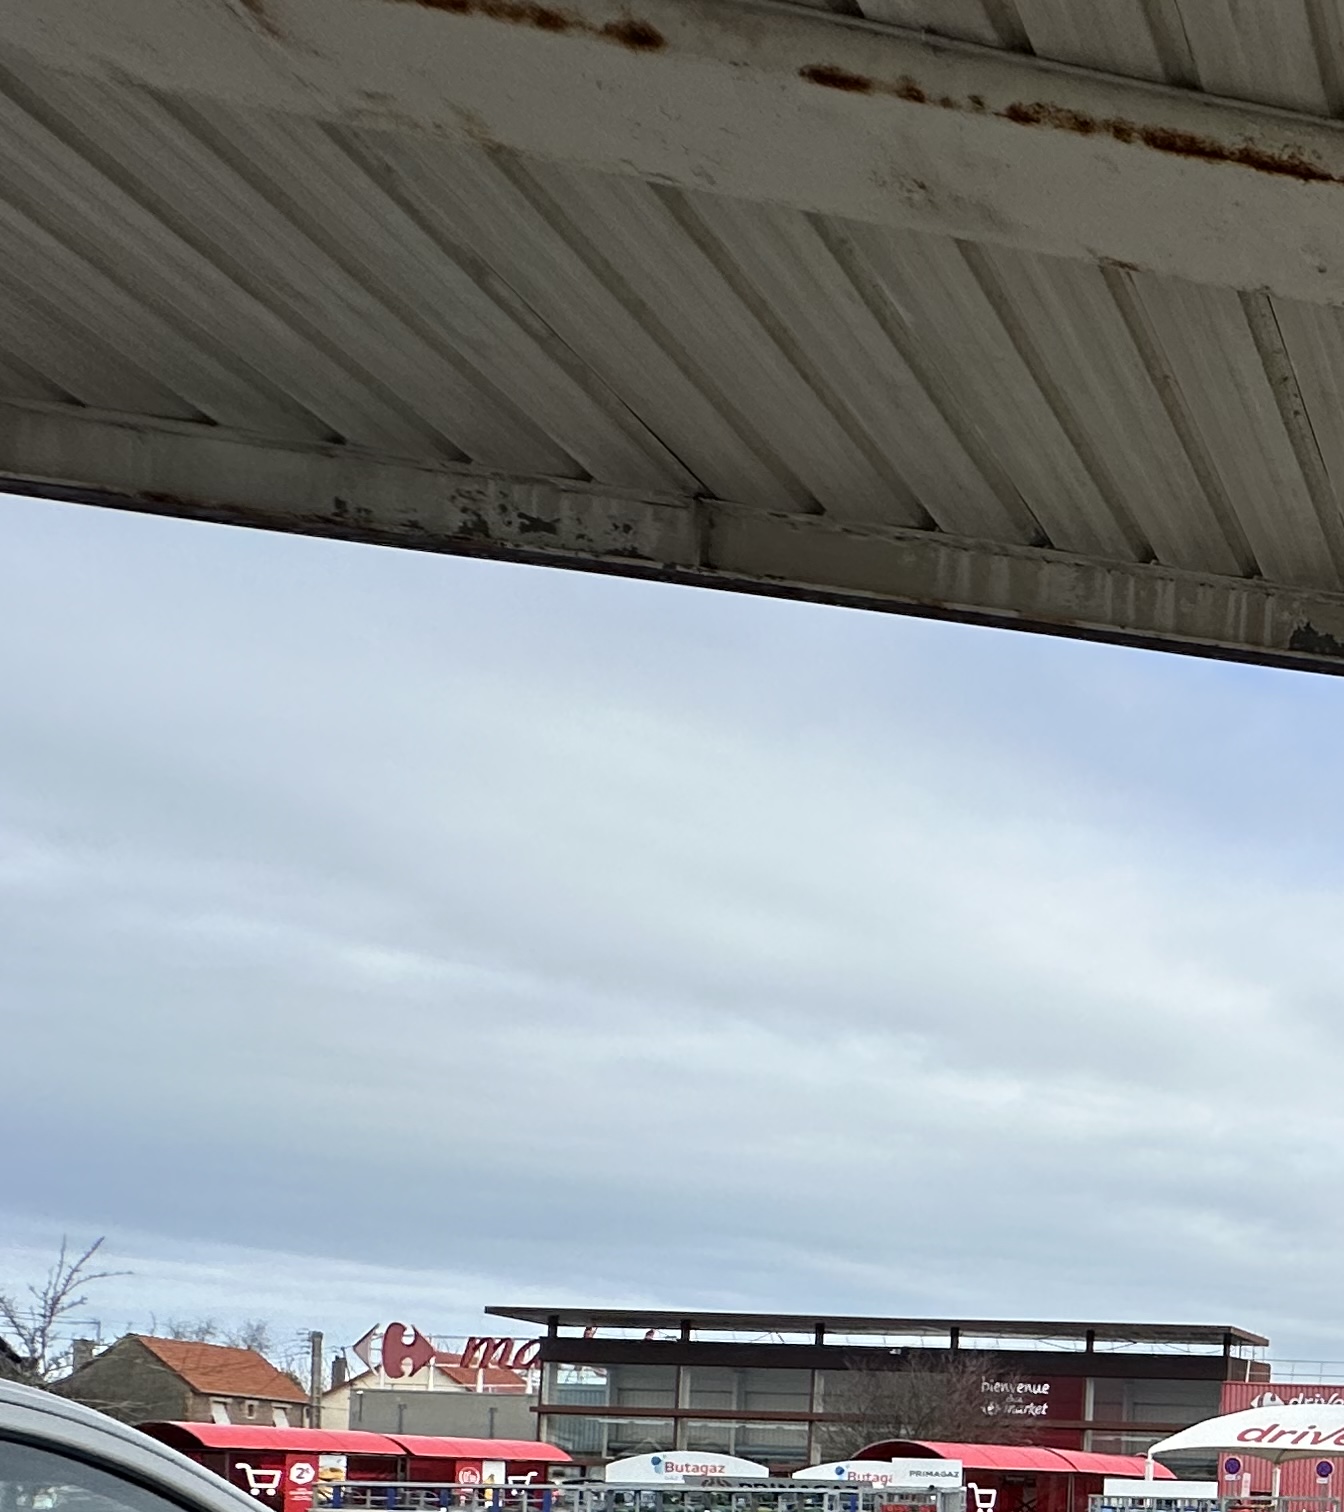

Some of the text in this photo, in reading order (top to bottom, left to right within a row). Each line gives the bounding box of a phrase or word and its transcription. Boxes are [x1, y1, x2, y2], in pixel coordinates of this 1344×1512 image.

[981, 1376, 1050, 1394] bienvenue
[1004, 1402, 1048, 1416] market
[664, 1461, 725, 1475] Butagaz
[908, 1470, 960, 1478] PRIMAGAZ
